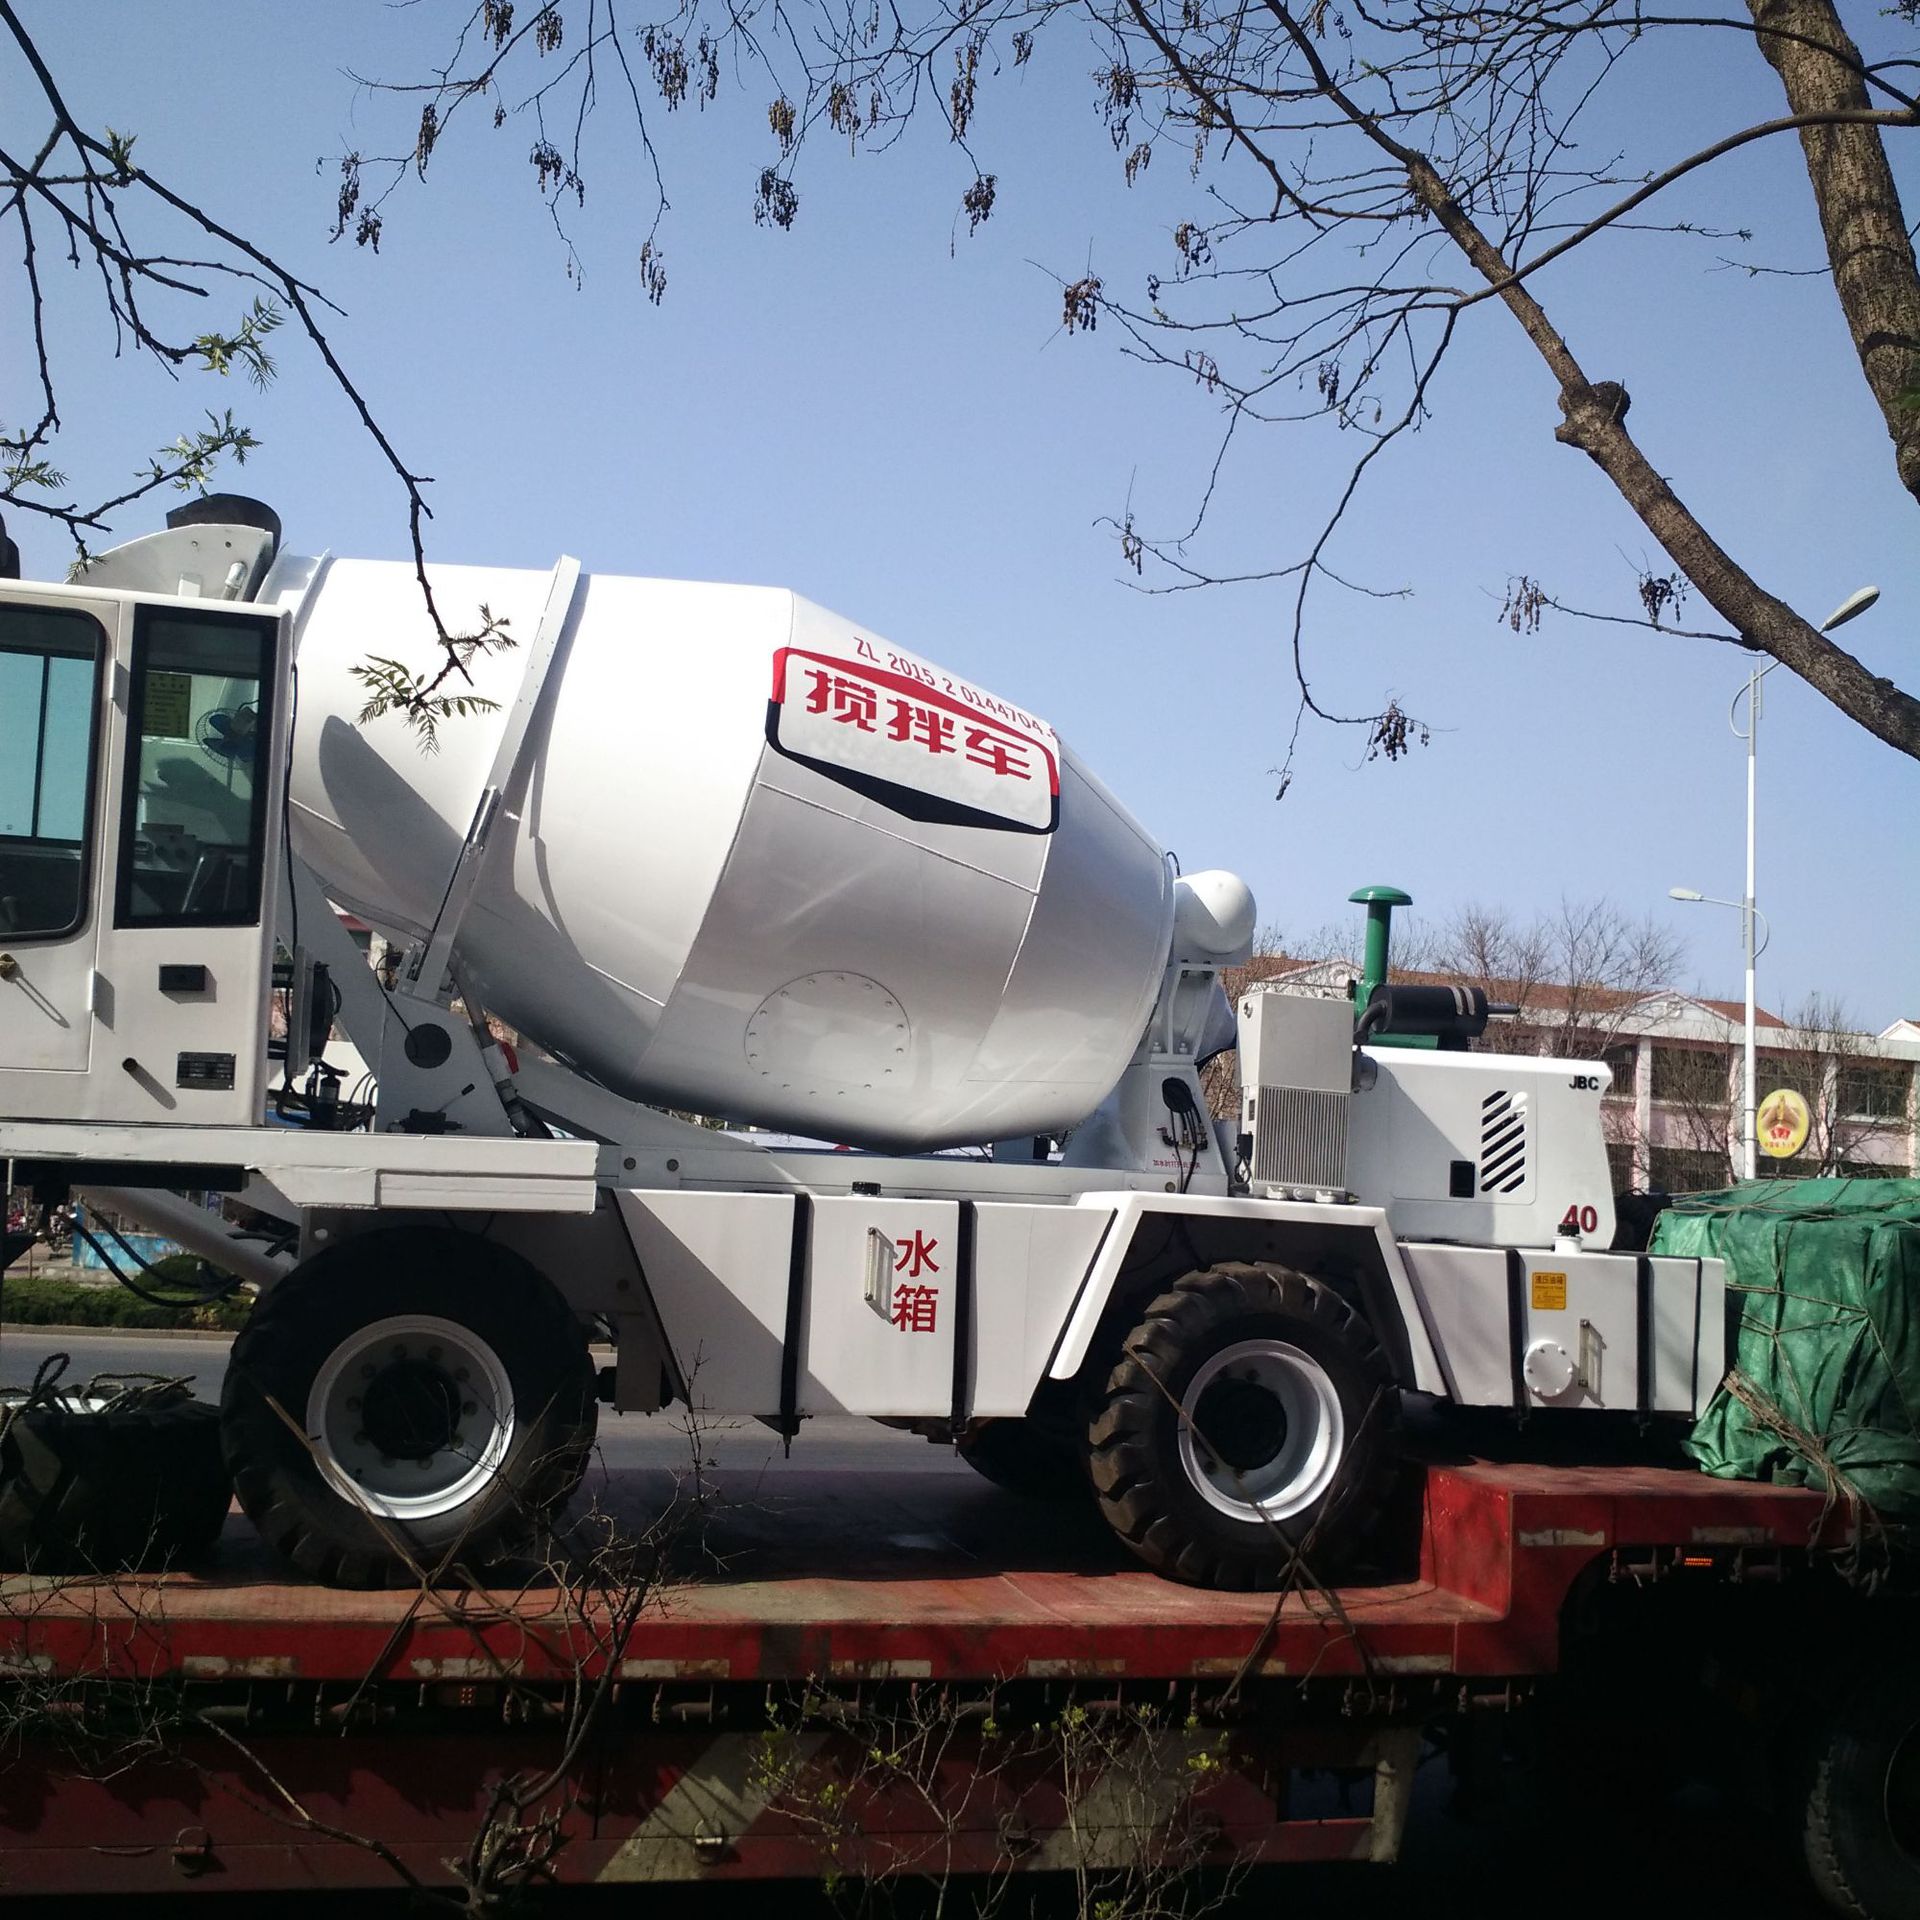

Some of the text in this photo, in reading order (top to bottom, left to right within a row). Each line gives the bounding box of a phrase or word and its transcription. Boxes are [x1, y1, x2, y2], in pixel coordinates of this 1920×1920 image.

[853, 636, 881, 663] ZL
[887, 652, 936, 686] 2015
[942, 677, 957, 696] 2
[804, 669, 1031, 780] 搅拌车
[1569, 1075, 1599, 1090] JBC
[1562, 1205, 1598, 1233] 40
[892, 1230, 940, 1332] 水箱
